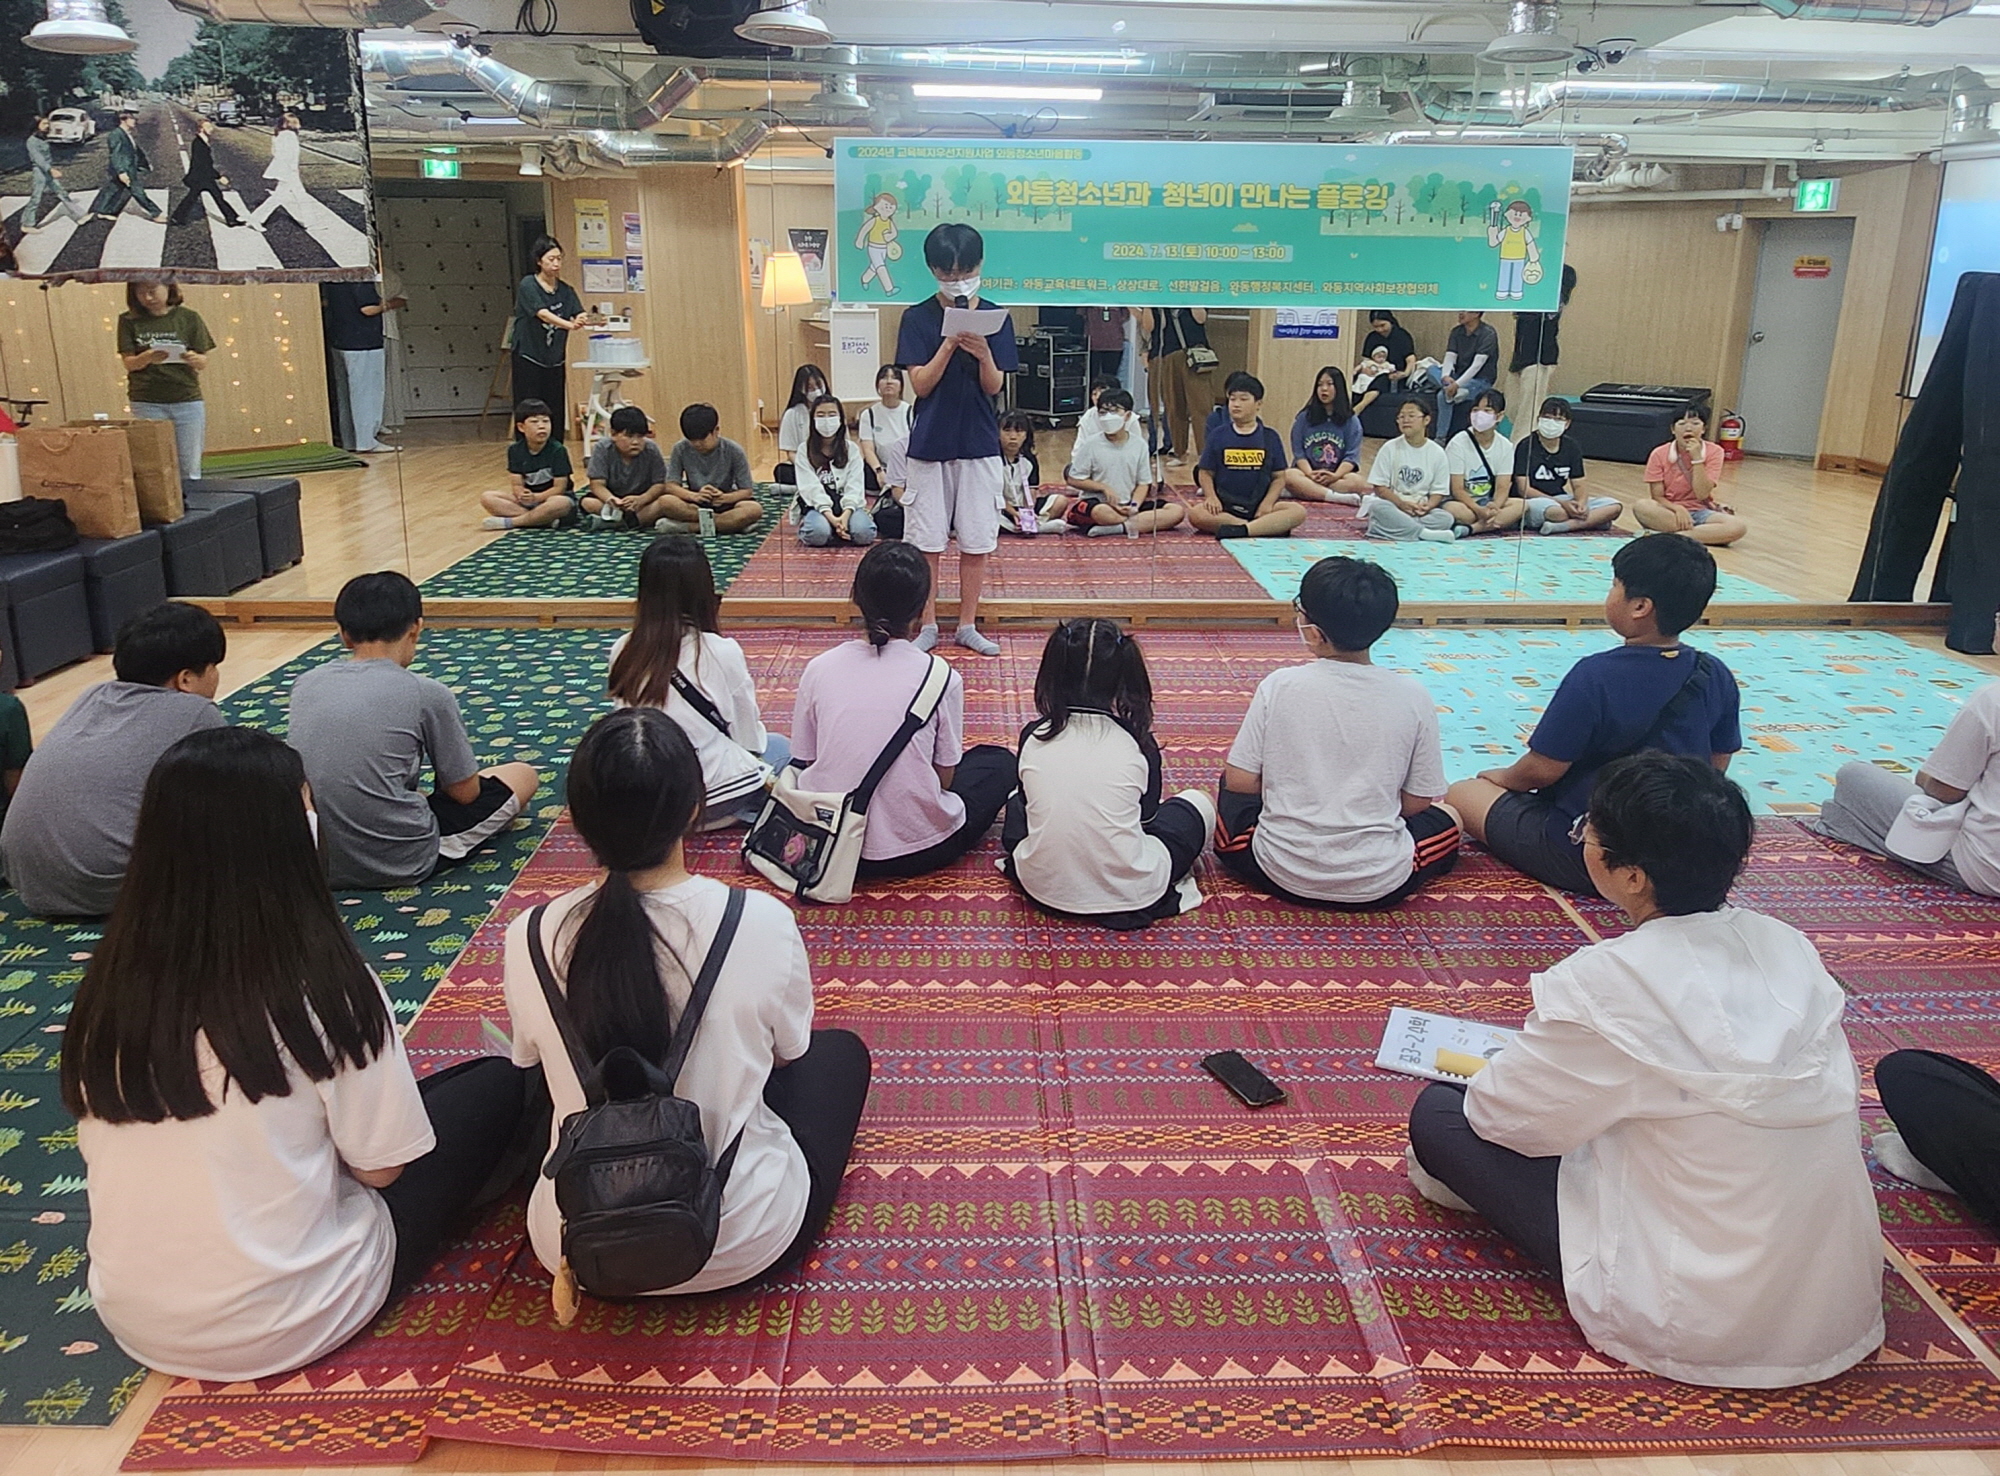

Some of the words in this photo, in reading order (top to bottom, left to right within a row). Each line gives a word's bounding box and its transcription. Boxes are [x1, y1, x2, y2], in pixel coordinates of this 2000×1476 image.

[858, 147, 895, 158] 2024년
[1006, 179, 1151, 208] 와동청소년과
[1163, 181, 1234, 209] 청년이
[1240, 183, 1311, 209] 만나는
[1316, 184, 1389, 210] 플로깅
[1112, 244, 1147, 258] 2024.
[1205, 245, 1239, 258] 10:00
[1252, 246, 1286, 259] 13:00
[981, 277, 1018, 290] 여기관:
